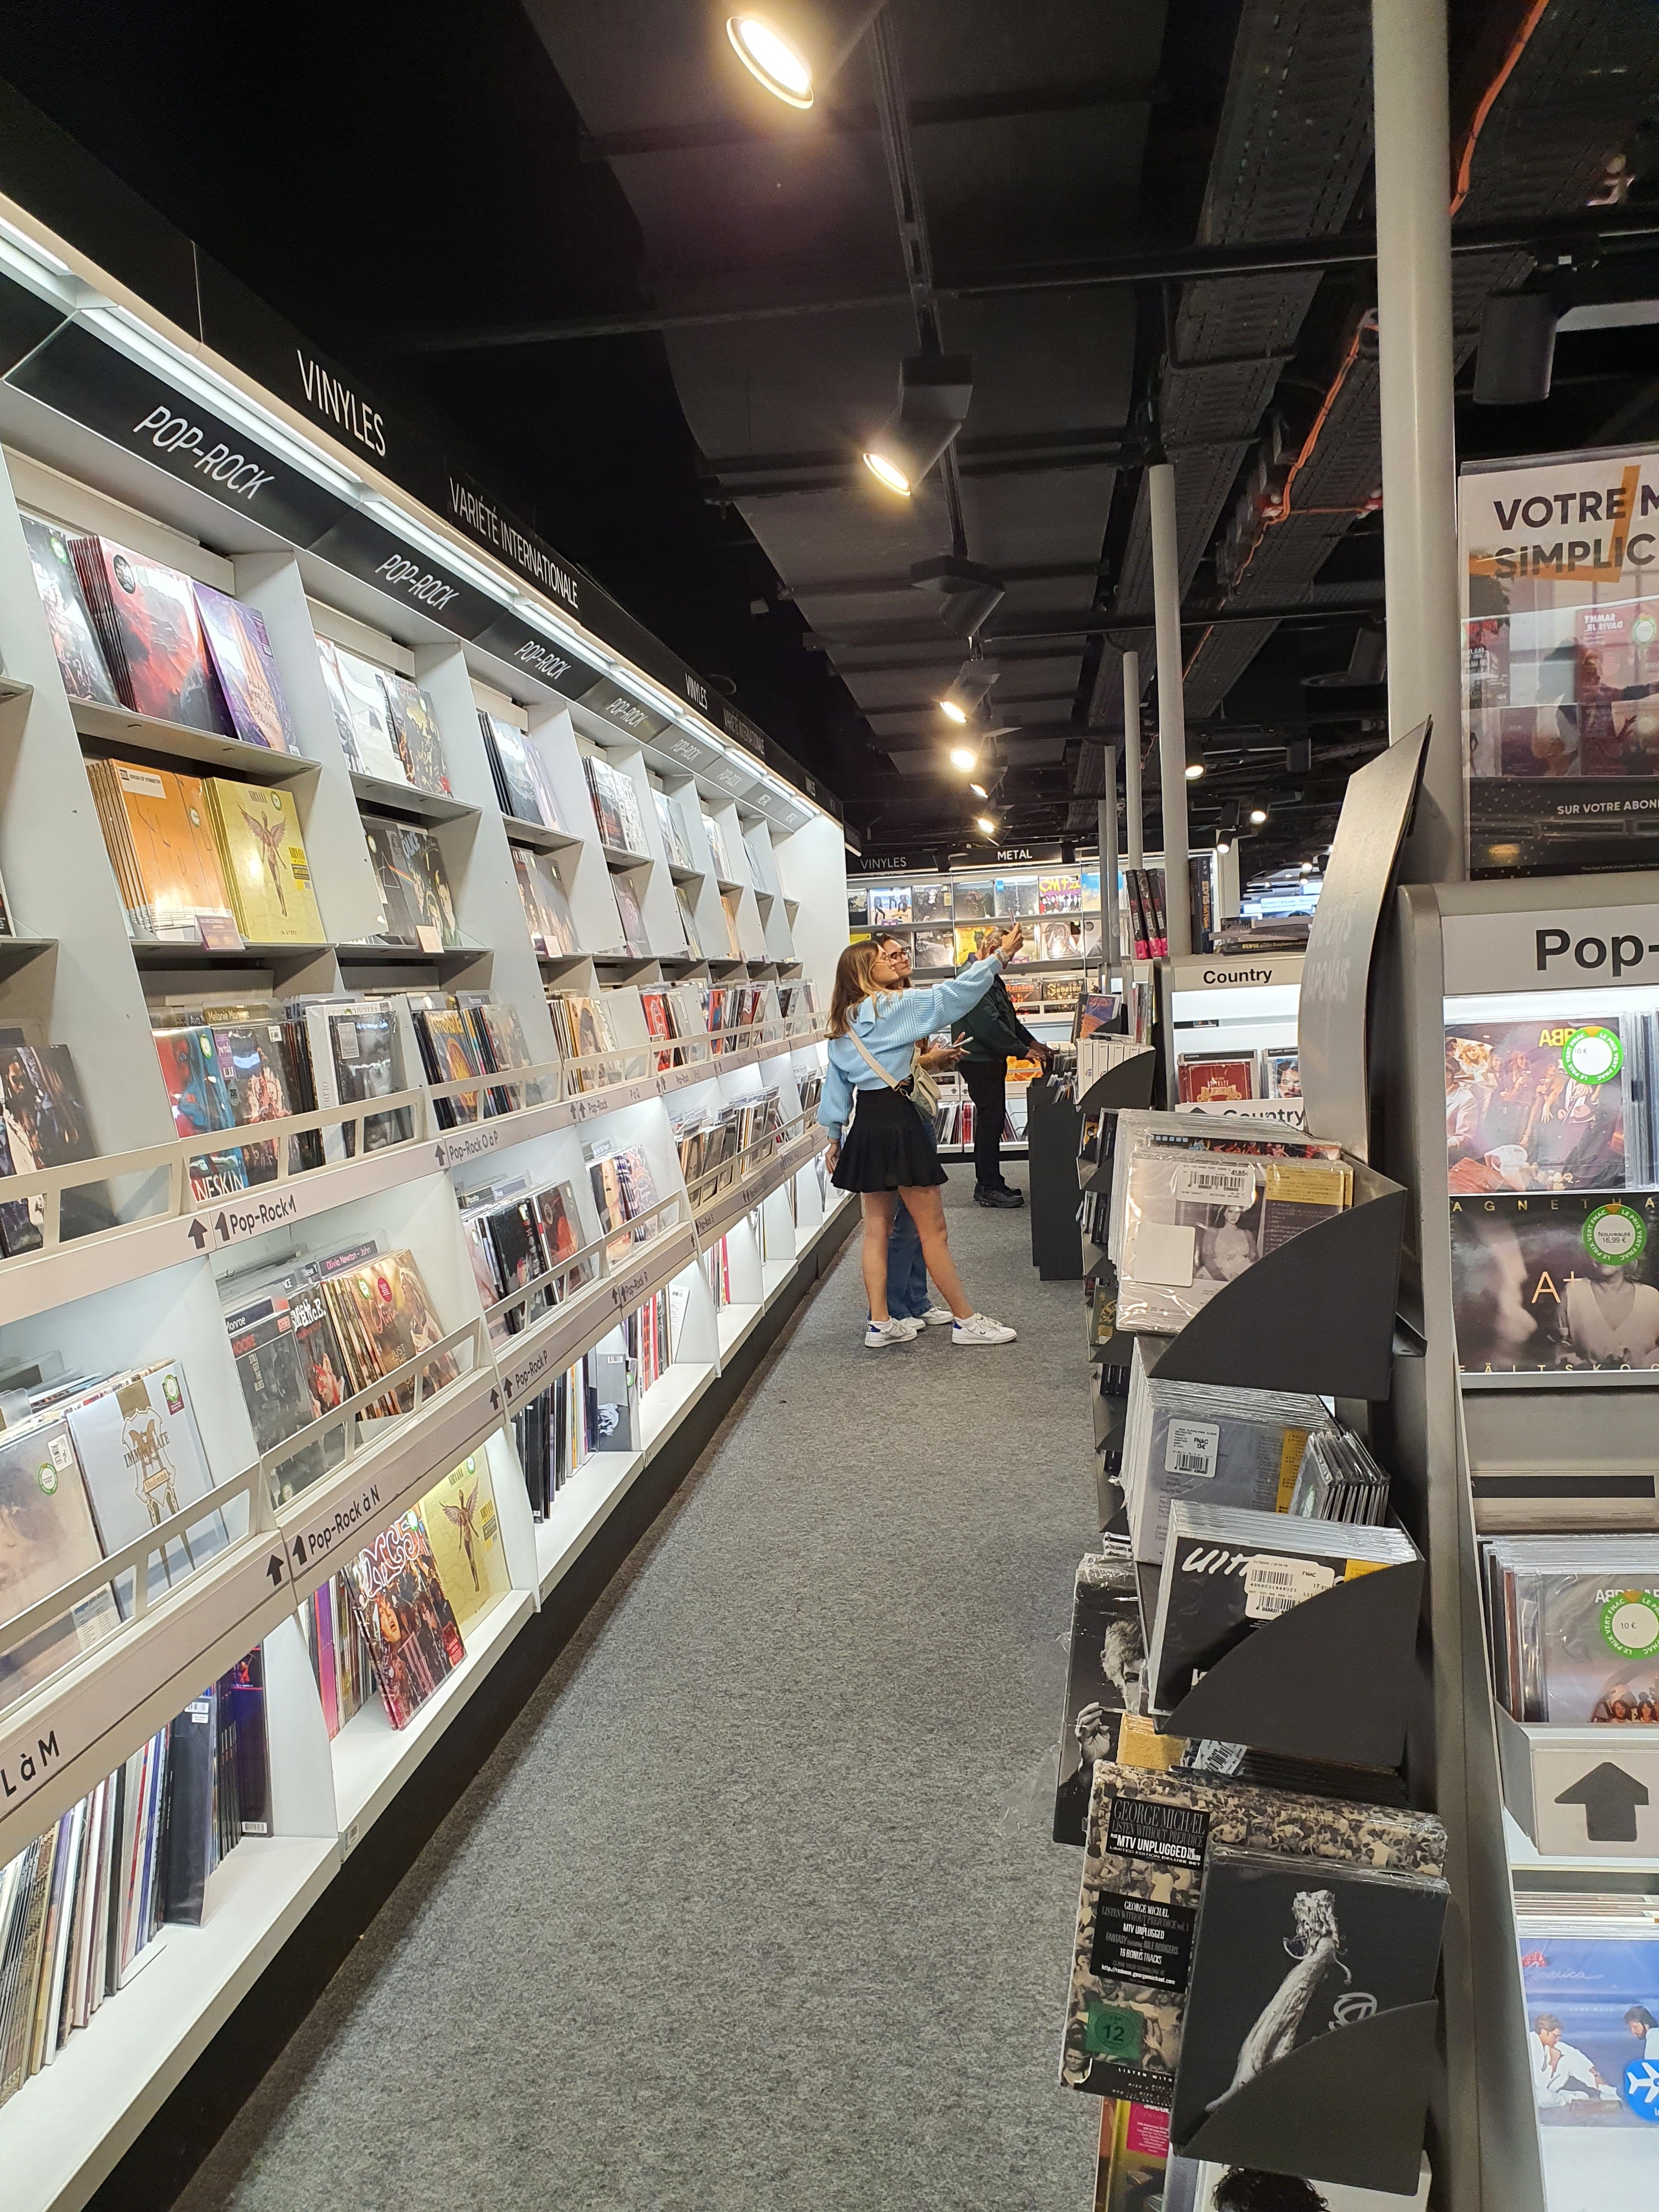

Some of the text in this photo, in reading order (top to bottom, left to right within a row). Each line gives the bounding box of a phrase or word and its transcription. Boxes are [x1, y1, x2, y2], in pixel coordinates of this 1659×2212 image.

[297, 349, 386, 456] VINYLES
[133, 406, 276, 500] POP-ROCK
[1493, 487, 1627, 531] VOTRE
[449, 477, 579, 610] VARIÉTÉ INTERNATIONALE
[375, 554, 459, 610] POP-ROCK
[514, 640, 572, 680] POP-ROCK
[685, 673, 708, 710] VINYLES
[606, 698, 648, 727] POP-ROCK
[670, 739, 702, 761] POP-ROCK
[1557, 799, 1659, 815] SUR VOTRE ABON
[861, 856, 907, 870] VINYLES
[997, 849, 1032, 861] METAL
[1536, 928, 1659, 977] Pop-
[1204, 969, 1272, 984] Country
[208, 1012, 228, 1022] Melanie
[449, 1139, 482, 1161] Pop-Rock
[229, 1200, 287, 1234] Pop-Rock
[1590, 1210, 1606, 1224] FNAC
[1629, 1215, 1641, 1229] PRIX
[340, 1254, 357, 1265] Newton
[360, 1246, 371, 1257] John
[1589, 1242, 1602, 1256] PRIX
[1620, 1248, 1637, 1260] FNAC
[306, 1267, 314, 1276] ew
[625, 1278, 644, 1297] Pop-Rock
[1531, 1271, 1582, 1304] A+
[391, 1343, 405, 1360] JUST
[515, 1350, 548, 1389] Pop-Rock P
[144, 1473, 168, 1491] Madonna
[308, 1484, 381, 1555] Pop-Rock à N
[1607, 1599, 1625, 1615] FNAC
[1607, 1635, 1623, 1650] PRIX
[2, 1731, 59, 1797] L à M
[1114, 1799, 1160, 1826] GEORGE
[1112, 1820, 1204, 1848] LISTEN WITHOUT PREJUDICE
[1110, 1846, 1134, 1854] LIMITED
[1135, 1850, 1160, 1859] EDITION
[1161, 1855, 1187, 1864] DELUXE
[1117, 1835, 1187, 1859] MTV UNPLUGGED
[1102, 1905, 1177, 1929] LISTEN WITHOUT PREJUDICE
[1124, 1901, 1147, 1914] GEORGE
[1123, 1923, 1165, 1939] MTV UNPLUGGED
[1106, 1932, 1128, 1945] FANTASY
[1155, 1942, 1179, 1955] RODGERS
[1120, 1948, 1163, 1965] 16 BONUS TRACKS
[1103, 2024, 1125, 2041] 12
[1118, 2067, 1147, 2078] LISTEN
